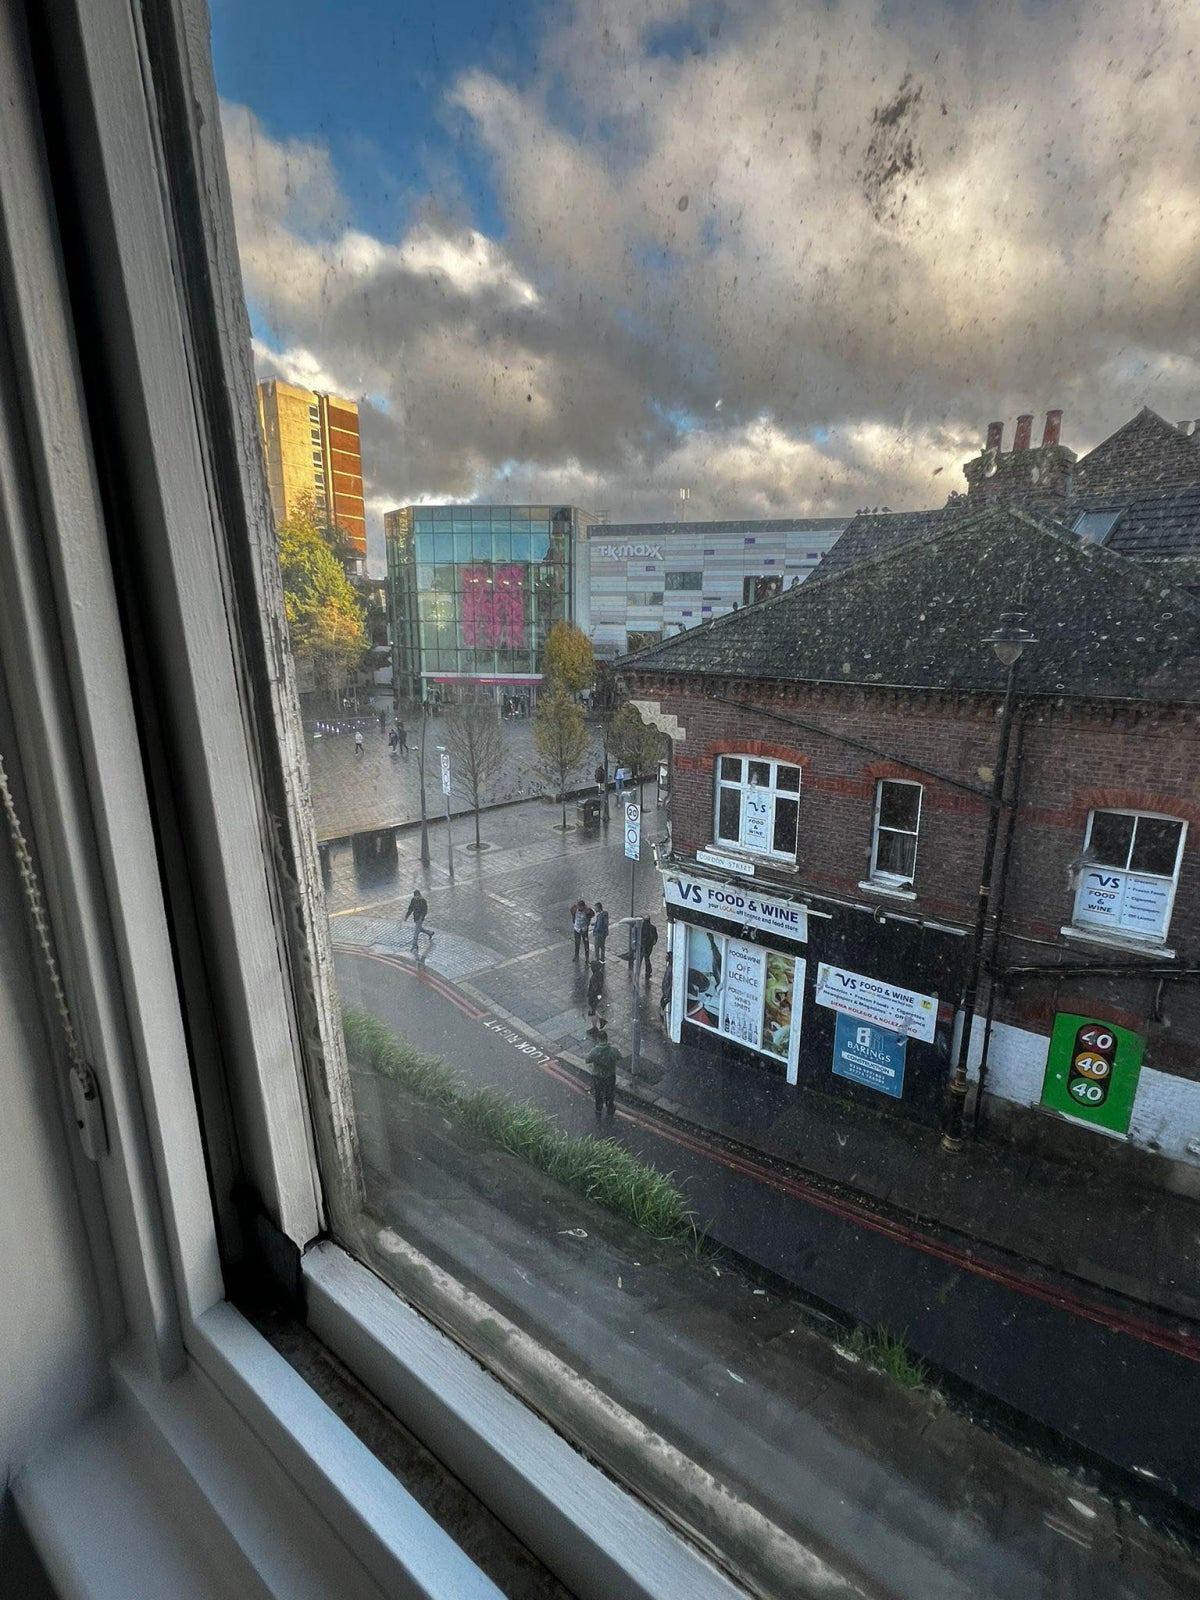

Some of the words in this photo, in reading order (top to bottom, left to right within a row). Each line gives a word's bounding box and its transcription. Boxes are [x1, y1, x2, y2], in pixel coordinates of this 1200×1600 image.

[729, 862, 751, 872] STREET
[1089, 873, 1120, 889] VS
[678, 881, 702, 904] VS
[708, 889, 745, 908] FOOD
[748, 901, 757, 912] &
[761, 903, 799, 924] WINE
[1088, 890, 1116, 900] FOOD
[719, 904, 735, 914] LOCAL
[761, 916, 772, 924] and
[772, 919, 784, 928] food
[785, 924, 799, 932] store
[1088, 904, 1113, 913] WINE
[728, 970, 758, 988] LICENCE
[835, 973, 857, 990] VS
[860, 981, 884, 994] FOOD
[892, 991, 915, 1004] WINE
[896, 1007, 925, 1021] Cigarettes
[483, 1020, 522, 1044] RIGHT
[1081, 1031, 1113, 1050] 40
[515, 1041, 551, 1064] LOOK
[847, 1040, 891, 1063] BARINGS
[1077, 1057, 1108, 1075] 40
[1072, 1082, 1102, 1101] 40
